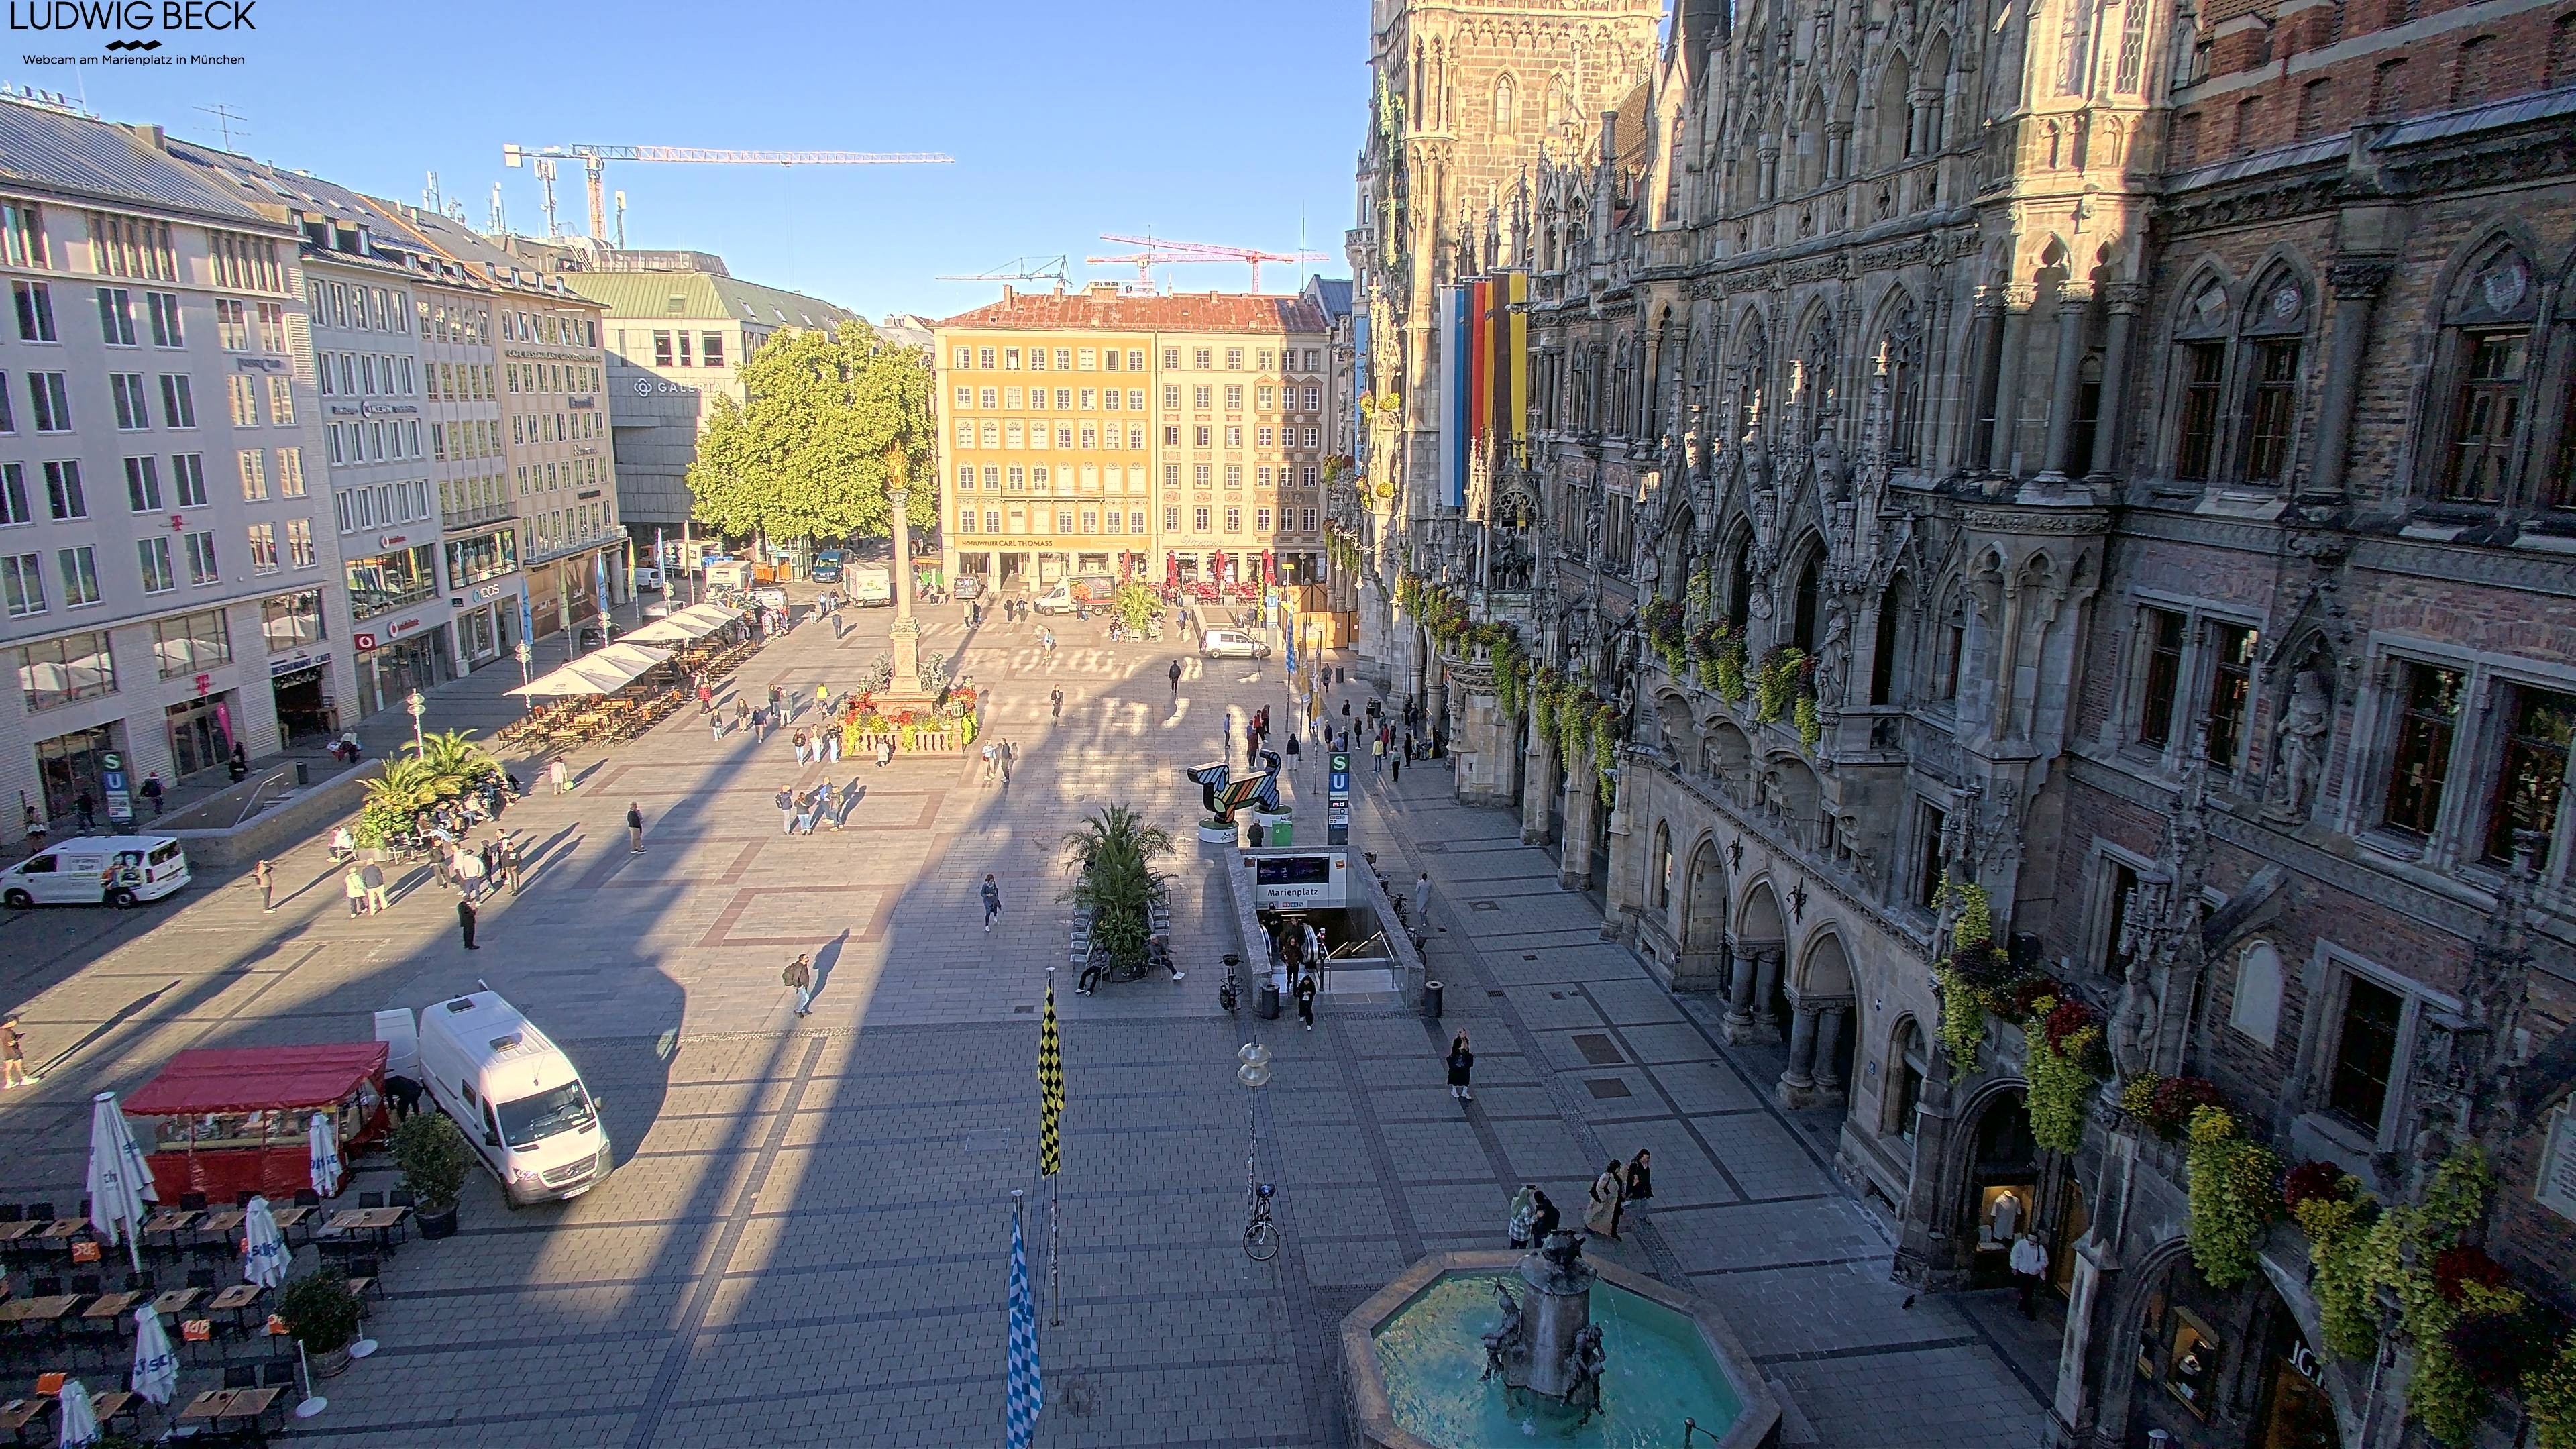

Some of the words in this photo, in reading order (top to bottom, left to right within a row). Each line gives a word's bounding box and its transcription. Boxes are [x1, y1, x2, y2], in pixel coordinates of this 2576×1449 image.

[657, 382, 722, 393] GALERIA
[105, 753, 120, 769] S
[1333, 756, 1346, 770] S
[108, 773, 122, 788] U
[1333, 775, 1344, 789] U
[1267, 888, 1318, 897] Marienplatz
